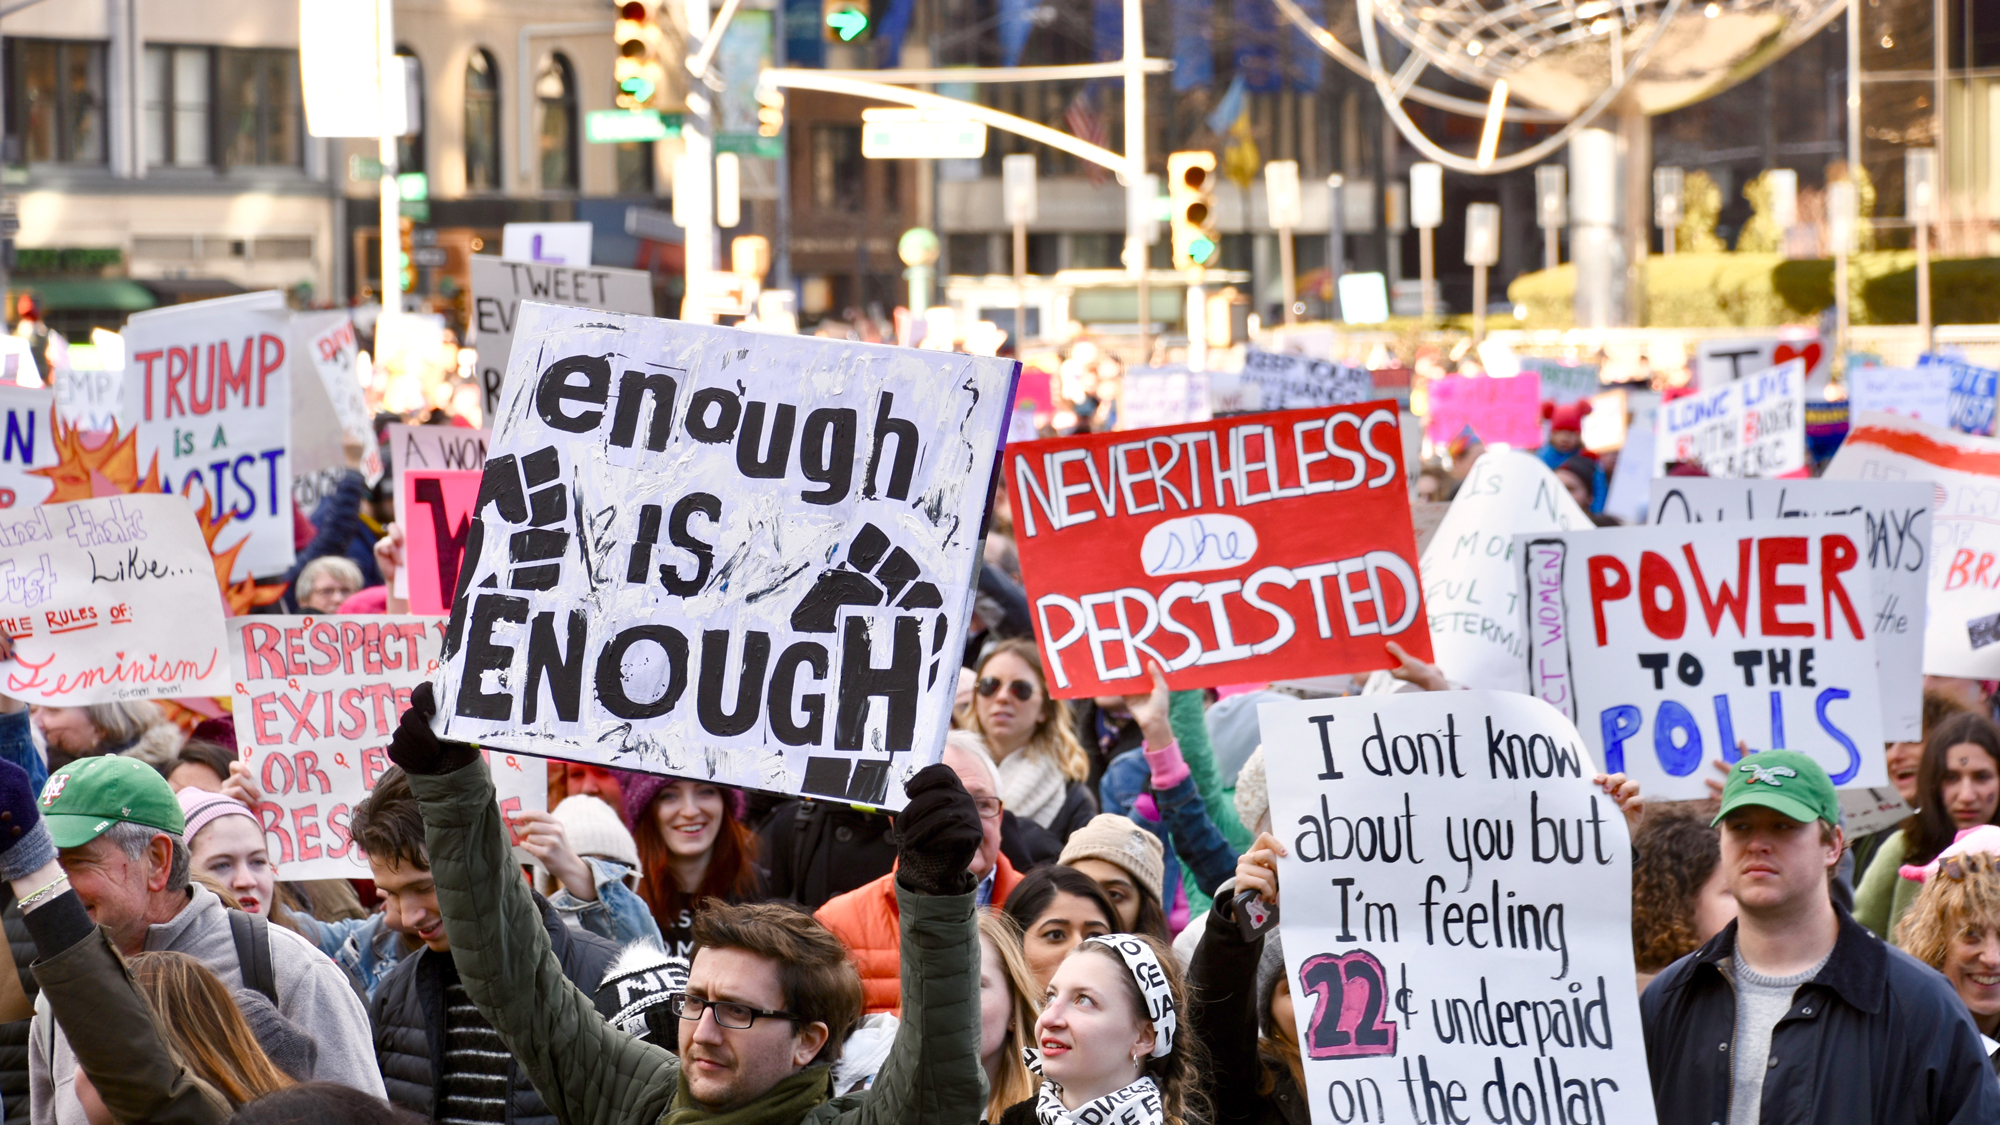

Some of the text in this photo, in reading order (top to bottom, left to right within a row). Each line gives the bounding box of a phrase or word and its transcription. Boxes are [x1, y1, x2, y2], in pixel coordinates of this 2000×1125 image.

[502, 263, 610, 305] TWEET
[135, 333, 285, 421] TRUMP
[211, 424, 227, 449] A
[405, 433, 428, 467] A
[536, 353, 919, 505] enough
[1014, 409, 1398, 537] NEVERTHELESS
[626, 491, 723, 598] IS
[1152, 517, 1248, 573] she
[45, 606, 98, 628] RULES
[1036, 551, 1420, 689] PERSISTED
[1537, 550, 1563, 647] WOMEN
[1587, 534, 1866, 648] POWER
[7, 648, 217, 697] Feminism
[240, 621, 426, 682] RESPECT
[456, 593, 923, 753] ENOUGH
[1638, 648, 1817, 690] TO THE
[261, 752, 332, 796] OR
[1309, 715, 1344, 781] I
[1486, 716, 1582, 780] know
[1295, 790, 1615, 894] about you but
[1332, 875, 1570, 981] I'm feeling
[1432, 975, 1614, 1057] underpaid
[1328, 1054, 1619, 1125] on the dollar
